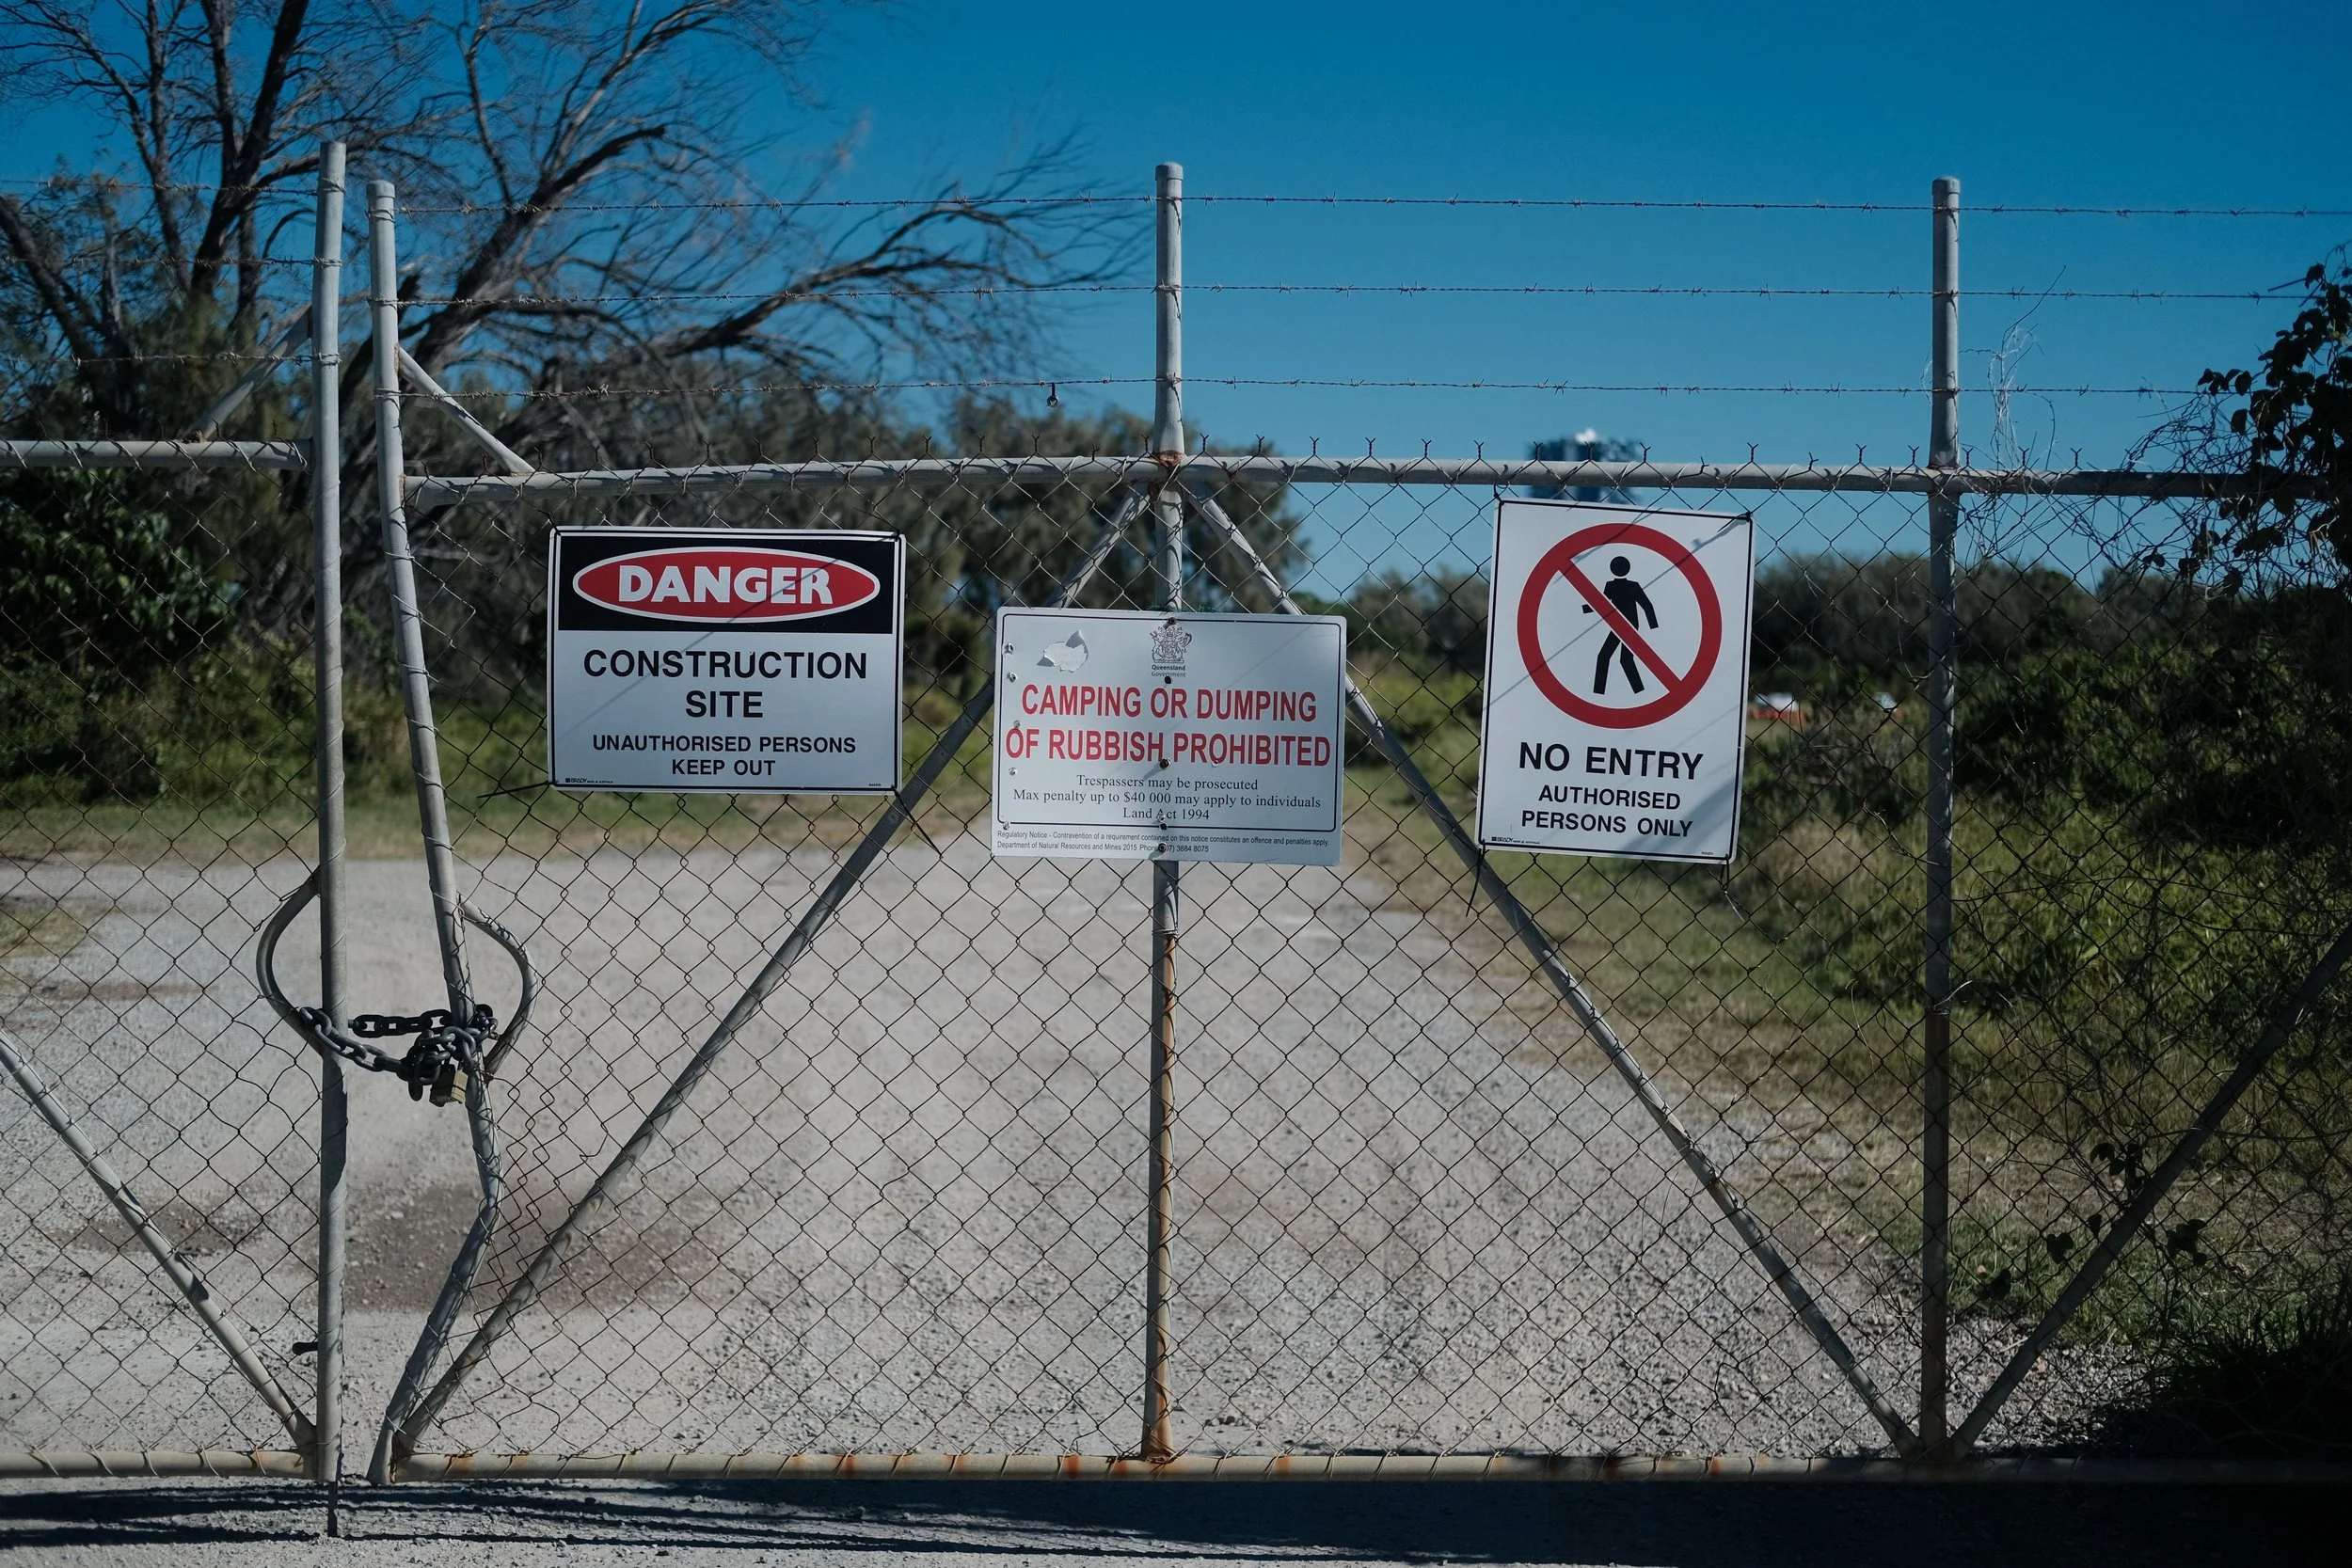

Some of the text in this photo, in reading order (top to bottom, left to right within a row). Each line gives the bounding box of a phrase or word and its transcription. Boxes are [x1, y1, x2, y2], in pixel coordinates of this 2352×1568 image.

[619, 564, 834, 605] DANGER
[583, 649, 866, 679] CONSTRUCTION
[685, 690, 764, 719] SITE
[1022, 684, 1316, 722] CAMPING OR DUMPING
[593, 735, 856, 753] UNAUTHORISED PERSONS
[1006, 727, 1330, 767] OF RUBBISH PROHIBITED
[672, 759, 775, 776] KEEP OUT
[1519, 741, 1703, 780] NO ENTRY
[1076, 774, 1258, 792] Trespassers may be prosecuted
[1013, 789, 1321, 808] Max penalty up to $40 000 may apply to individuals
[1538, 784, 1681, 810] AUTHORISED
[1123, 807, 1210, 820] Land Act 1994
[1522, 811, 1693, 837] PERSONS ONLY
[997, 831, 1027, 839] Regulatory
[1210, 835, 1240, 844] constitutes
[1251, 836, 1271, 845] offence
[1287, 838, 1311, 847] penalties
